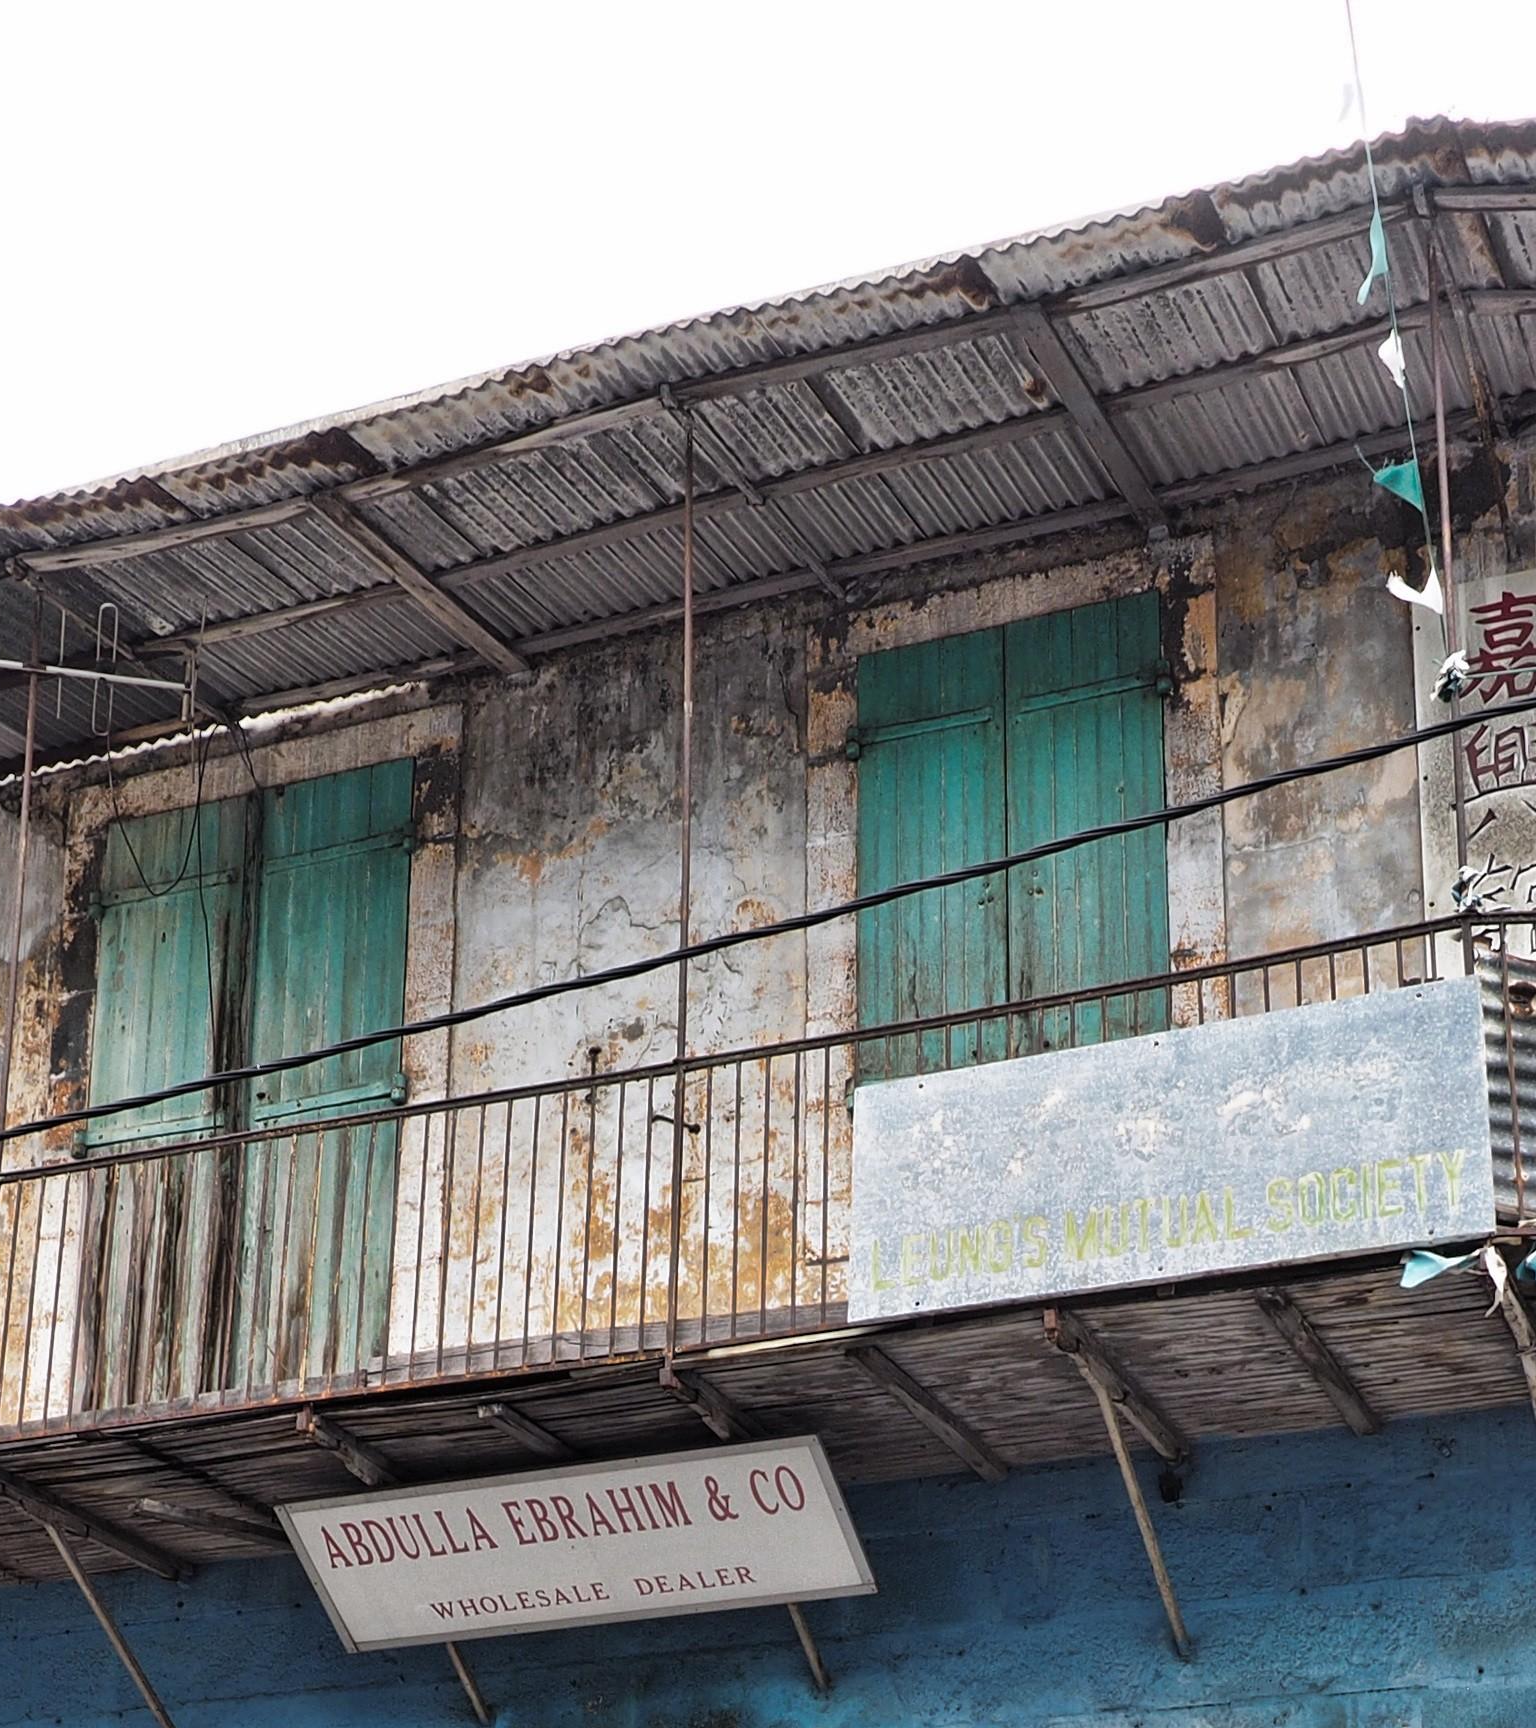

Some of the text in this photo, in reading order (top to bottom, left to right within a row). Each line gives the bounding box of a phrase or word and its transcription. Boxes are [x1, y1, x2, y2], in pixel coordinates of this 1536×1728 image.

[869, 1147, 1467, 1294] LEUNG'S MUTUAL SOCIETY
[320, 1464, 807, 1569] ABDULLA EBRAHIM & CO
[431, 1566, 757, 1621] WHOLESALE DEALER
